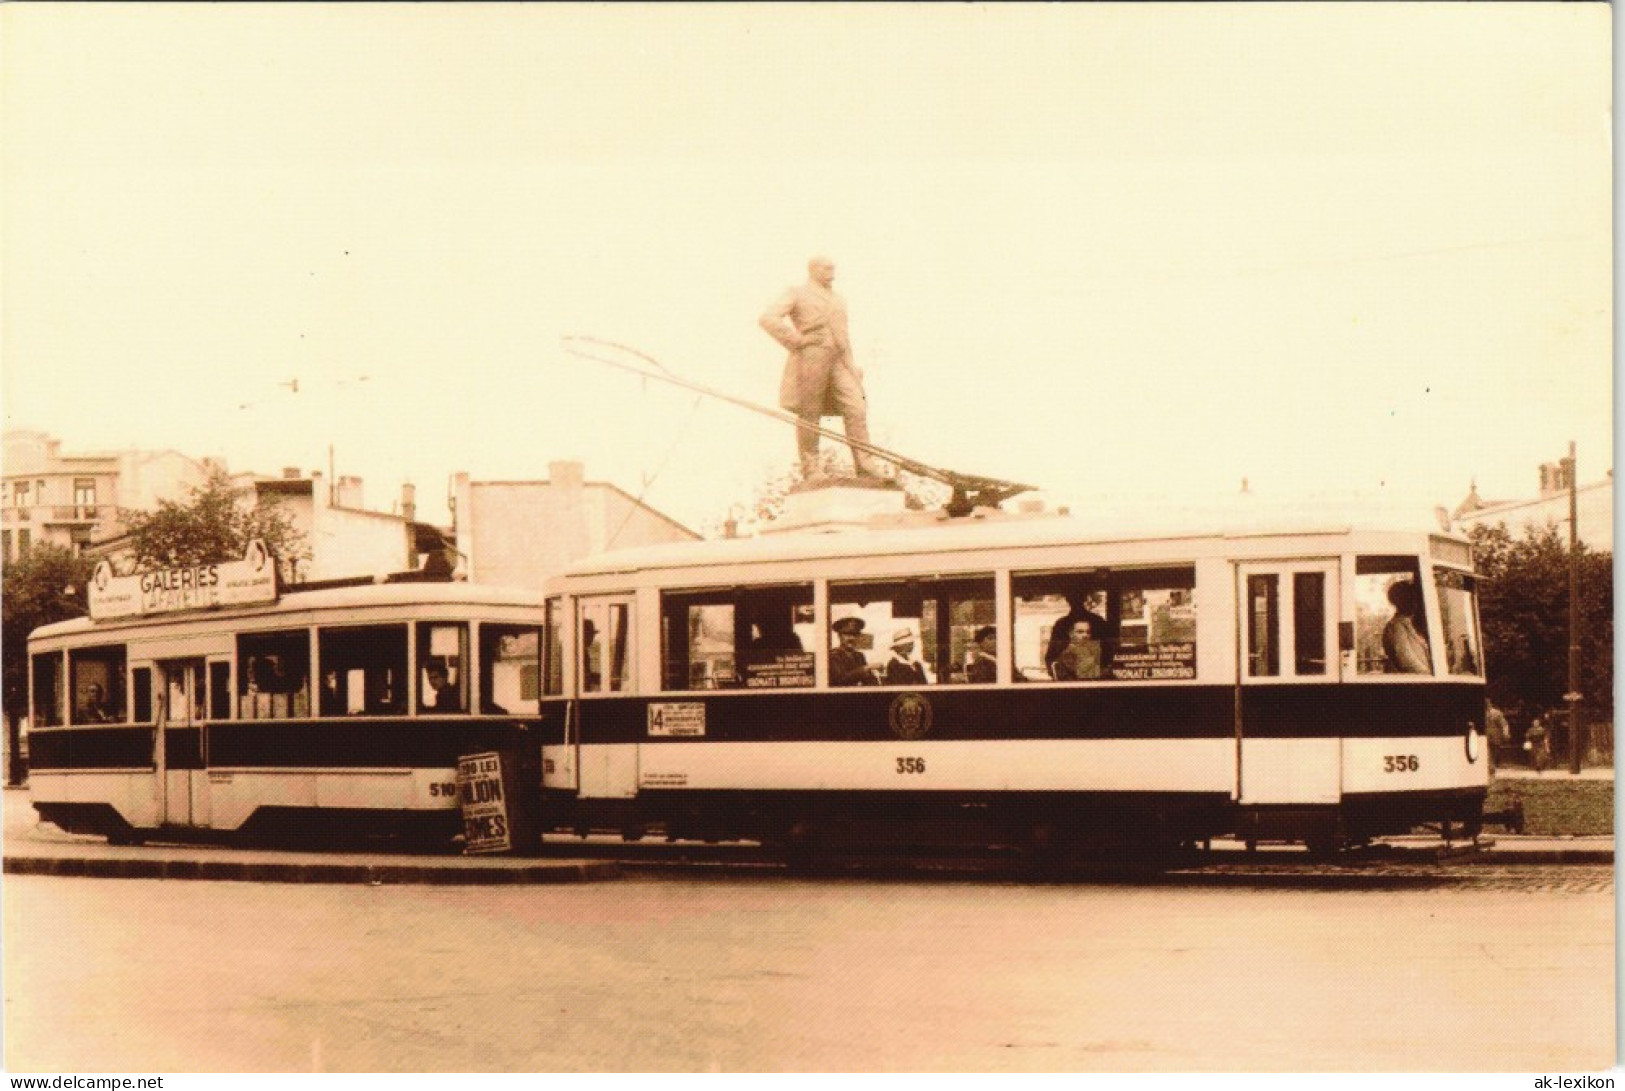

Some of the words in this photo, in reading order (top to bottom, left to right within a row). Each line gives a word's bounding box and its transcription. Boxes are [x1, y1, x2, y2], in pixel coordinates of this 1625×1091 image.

[141, 566, 219, 594] GALERIES
[650, 709, 664, 731] 14
[896, 757, 926, 774] 356
[1383, 755, 1419, 773] 356
[430, 783, 456, 797] 510
